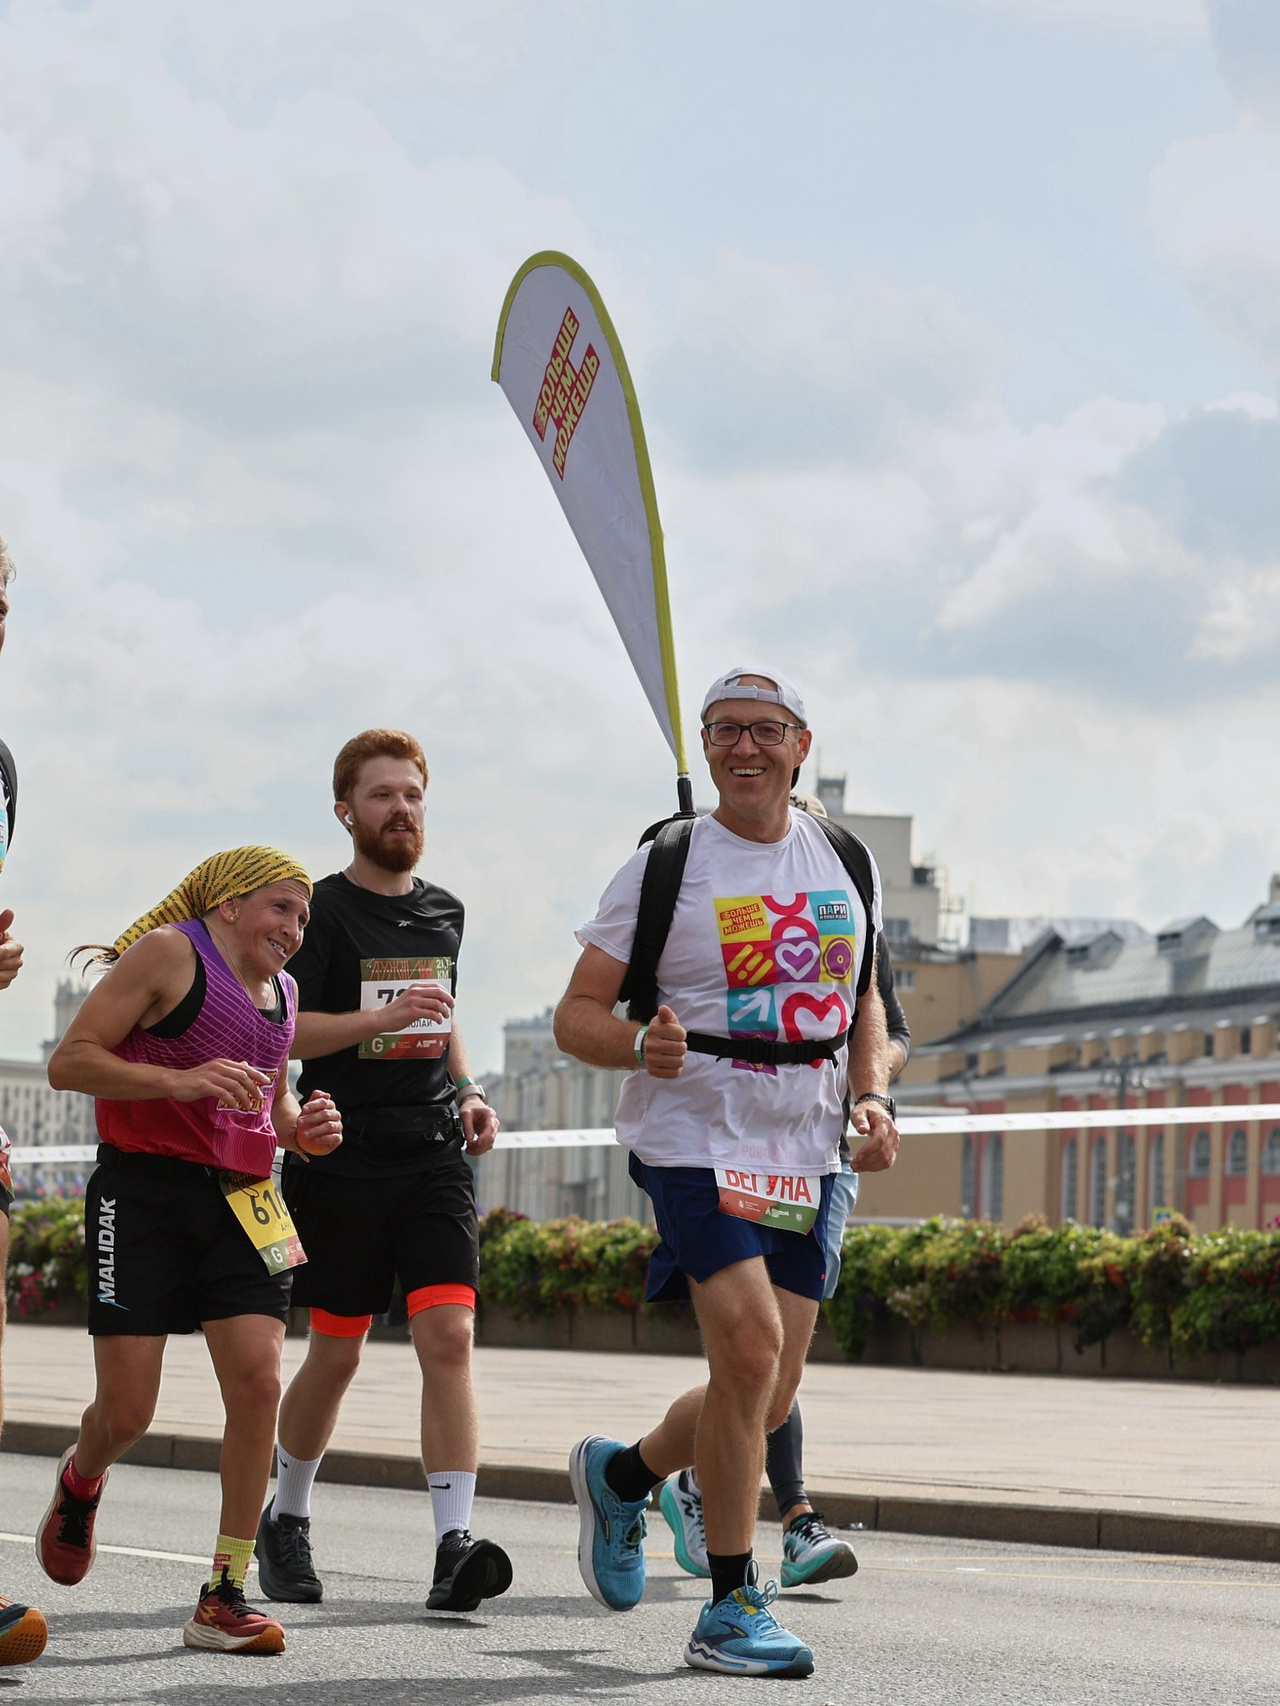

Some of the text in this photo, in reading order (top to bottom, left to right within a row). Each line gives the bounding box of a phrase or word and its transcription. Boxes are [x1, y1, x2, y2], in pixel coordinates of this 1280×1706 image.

[536, 310, 578, 424] БОЛЬШЕ
[550, 361, 577, 420] ЧЕМ
[552, 353, 598, 477] МОЖЕШЬ
[724, 904, 759, 918] БОЛЬШЕ
[819, 904, 847, 916] ПАРИ
[732, 913, 754, 924] ЧЕМ
[724, 919, 763, 935] МОЖЕШЬ
[371, 1037, 384, 1053] G
[98, 1196, 116, 1304] MALIDAK
[271, 1247, 283, 1264] G
